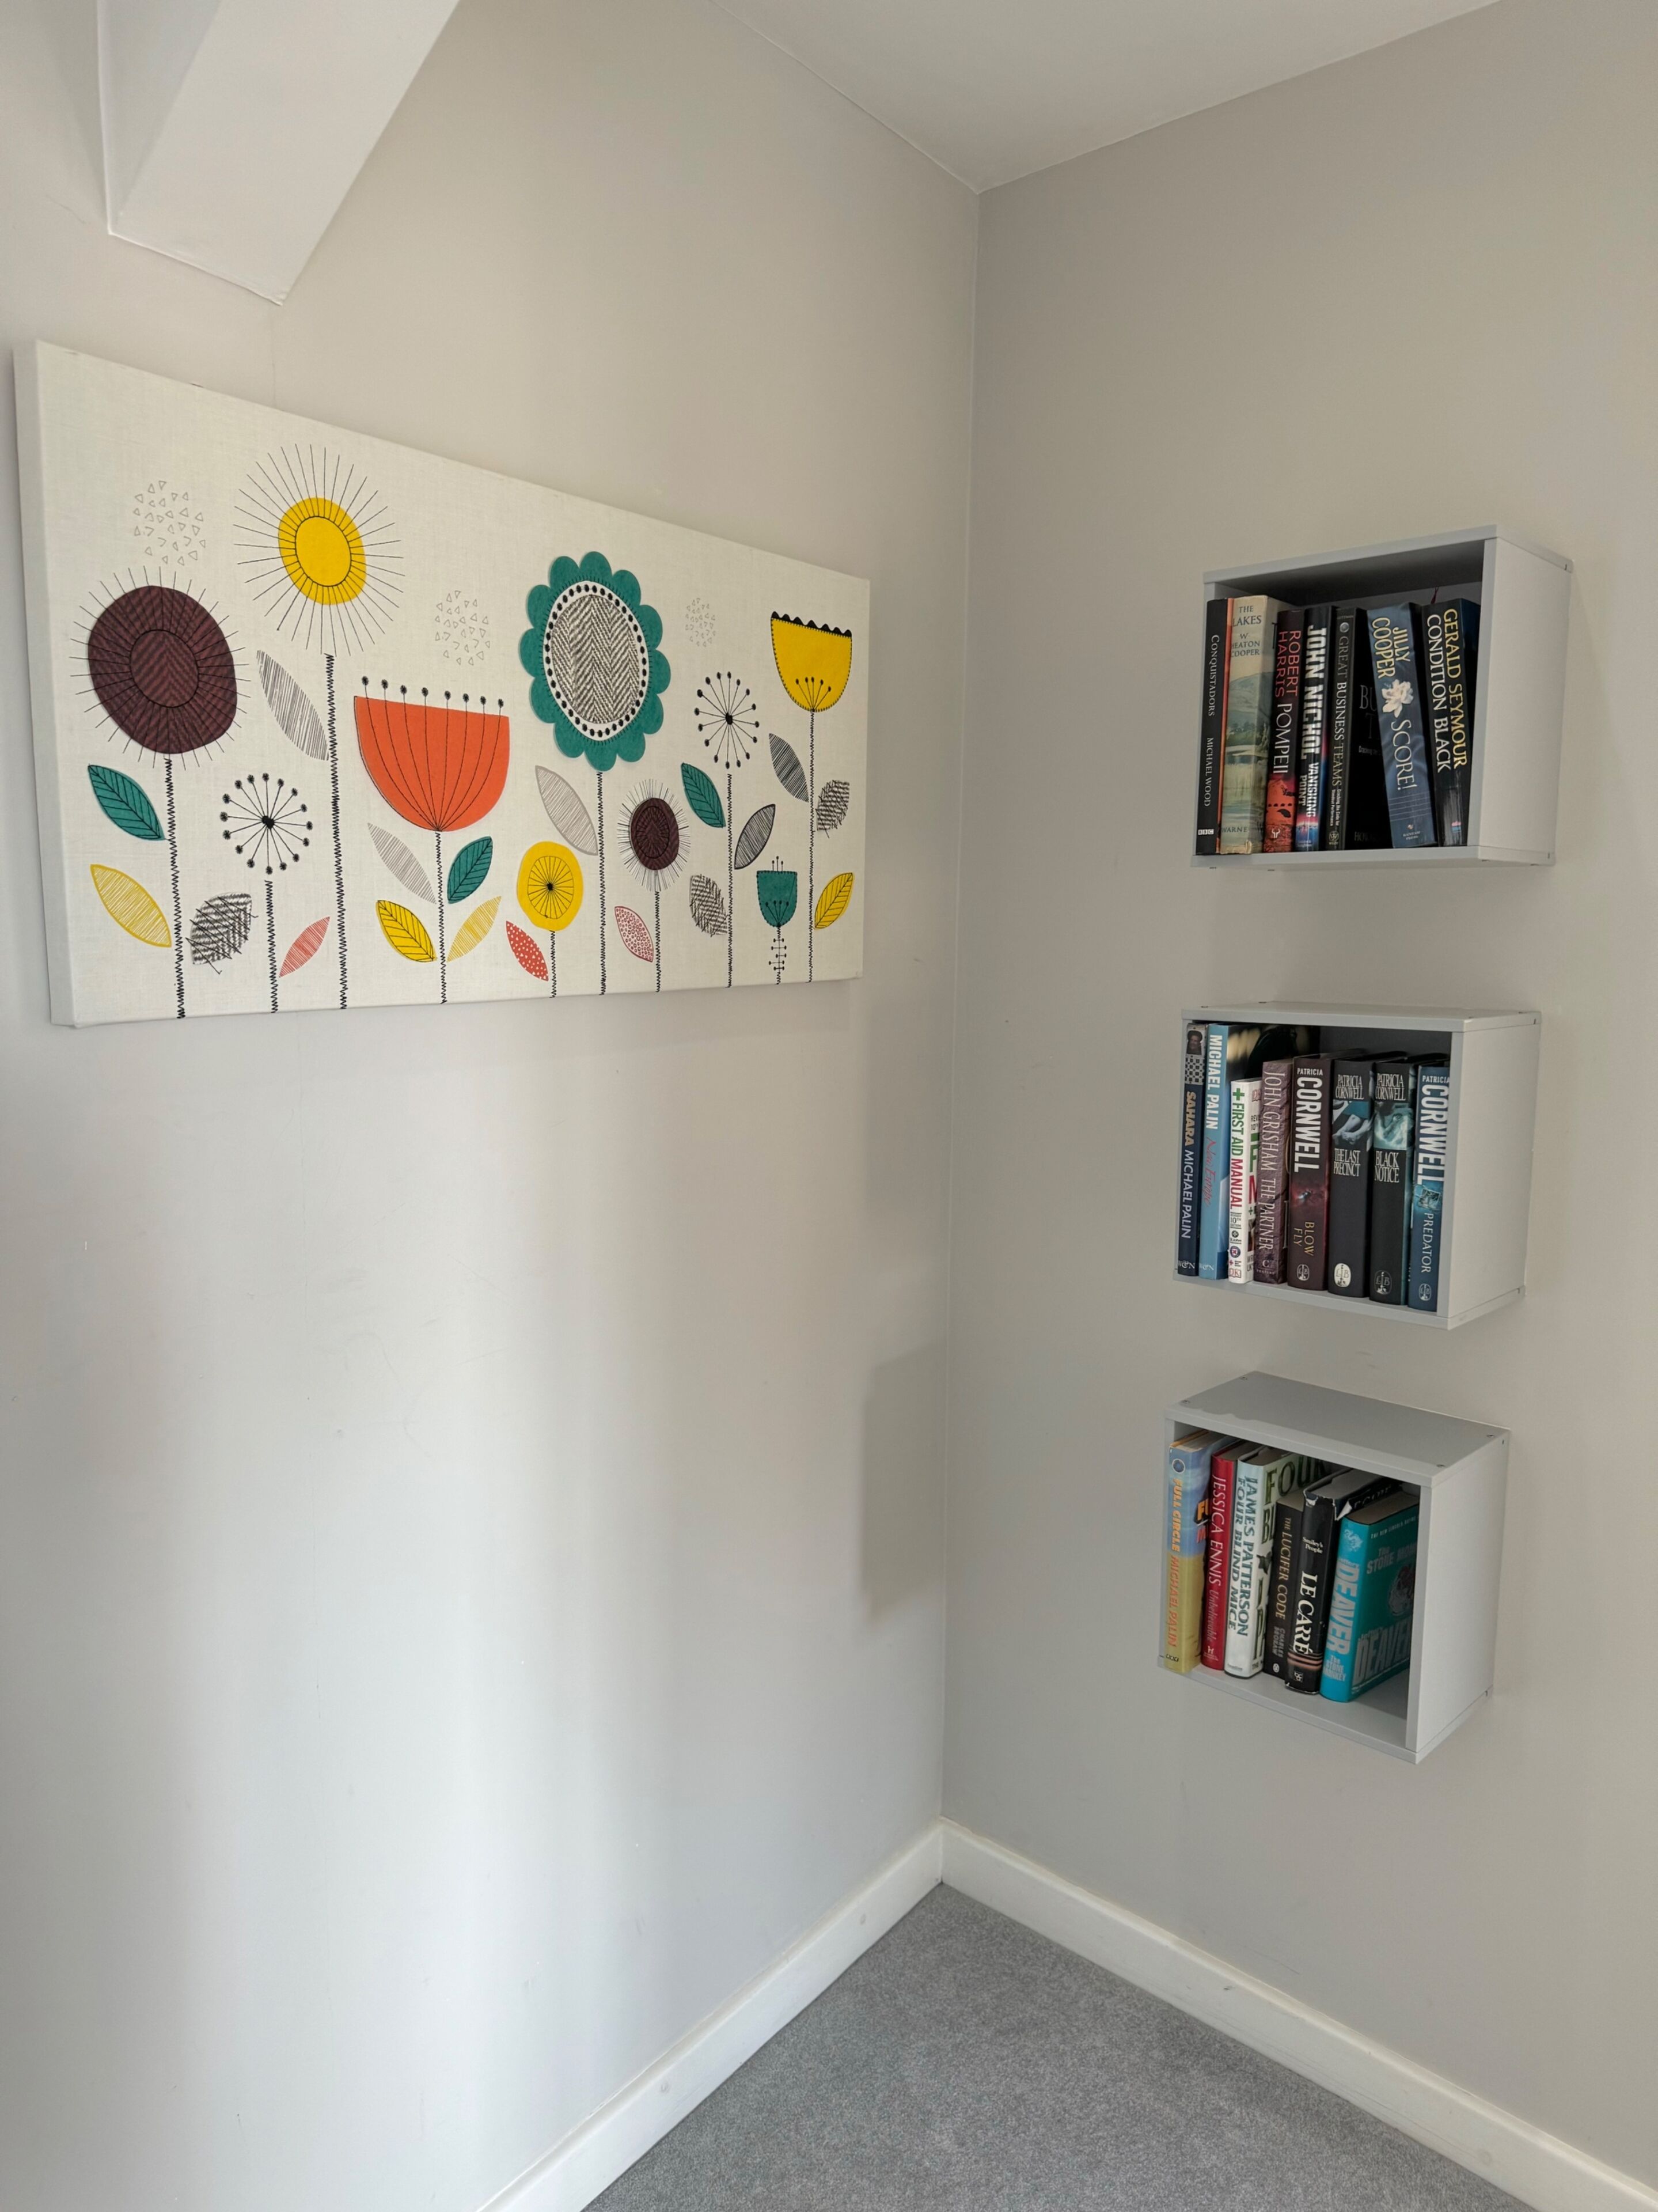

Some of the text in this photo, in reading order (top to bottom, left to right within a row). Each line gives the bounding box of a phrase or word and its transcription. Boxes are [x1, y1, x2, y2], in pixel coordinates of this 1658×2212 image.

[1231, 641, 1260, 649] HEATON
[1232, 615, 1262, 627] LAKES
[1372, 618, 1395, 679] COOPER
[1393, 627, 1410, 662] JILLY
[1208, 634, 1220, 717] CONQUISTADORS
[1231, 649, 1260, 658] COOPER
[1275, 631, 1288, 698] HARRIS
[1286, 630, 1302, 696] ROBERT
[1300, 624, 1327, 760] JOHN NICHOL
[1331, 636, 1349, 786] GREAT BUSINESS TEAMS
[1427, 614, 1451, 773] CONDITION BLACK
[1443, 608, 1467, 769] GERALD SEYMOUR
[1273, 703, 1292, 774] POMPEII
[1391, 719, 1418, 790] SCORE!
[1204, 737, 1214, 806] MICHAEL WOOD
[1298, 774, 1307, 806] POINT
[1306, 762, 1319, 817] VANISHING
[1206, 1035, 1223, 1130] MICHAEL PALIN
[1297, 1067, 1323, 1076] PATRICIA
[1335, 1087, 1364, 1100] CORNWELL
[1338, 1074, 1363, 1088] PATRICIA
[1375, 1085, 1406, 1100] CORNWELL
[1377, 1073, 1404, 1088] PATRICIA
[1422, 1075, 1450, 1084] PATRICIA
[1294, 1077, 1323, 1173] CORNWELL
[1417, 1084, 1448, 1185] CORNWELL
[1181, 1091, 1196, 1239] SAHARA MICHAEL PALIN
[1230, 1103, 1245, 1209] FIRST AID MANUAL
[1258, 1070, 1285, 1250] JOHN GRISHAM THE PARTNER
[1333, 1161, 1361, 1177] PRECINCT
[1334, 1148, 1360, 1164] THE LAST
[1375, 1166, 1399, 1183] NOTICE
[1376, 1151, 1399, 1168] BLACK
[1293, 1228, 1303, 1247] FLY
[1304, 1222, 1315, 1256] BLOW
[1421, 1213, 1434, 1273] PREDATOR
[1211, 1475, 1226, 1533] JESSICA
[1167, 1478, 1182, 1647] FULL CIRCLE MICHAEL PALIN
[1209, 1540, 1223, 1586] ENNIS
[1228, 1478, 1246, 1631] FOUR BLIND MICE
[1237, 1476, 1258, 1637] JAMES PATTERSON
[1278, 1532, 1292, 1581] LUCIFER
[1302, 1537, 1323, 1548] Smiley's
[1305, 1543, 1323, 1554] People
[1276, 1584, 1288, 1620] CODE
[1300, 1571, 1318, 1598] LE
[1326, 1560, 1360, 1655] DEAVER
[1293, 1599, 1314, 1655] CARRÉ
